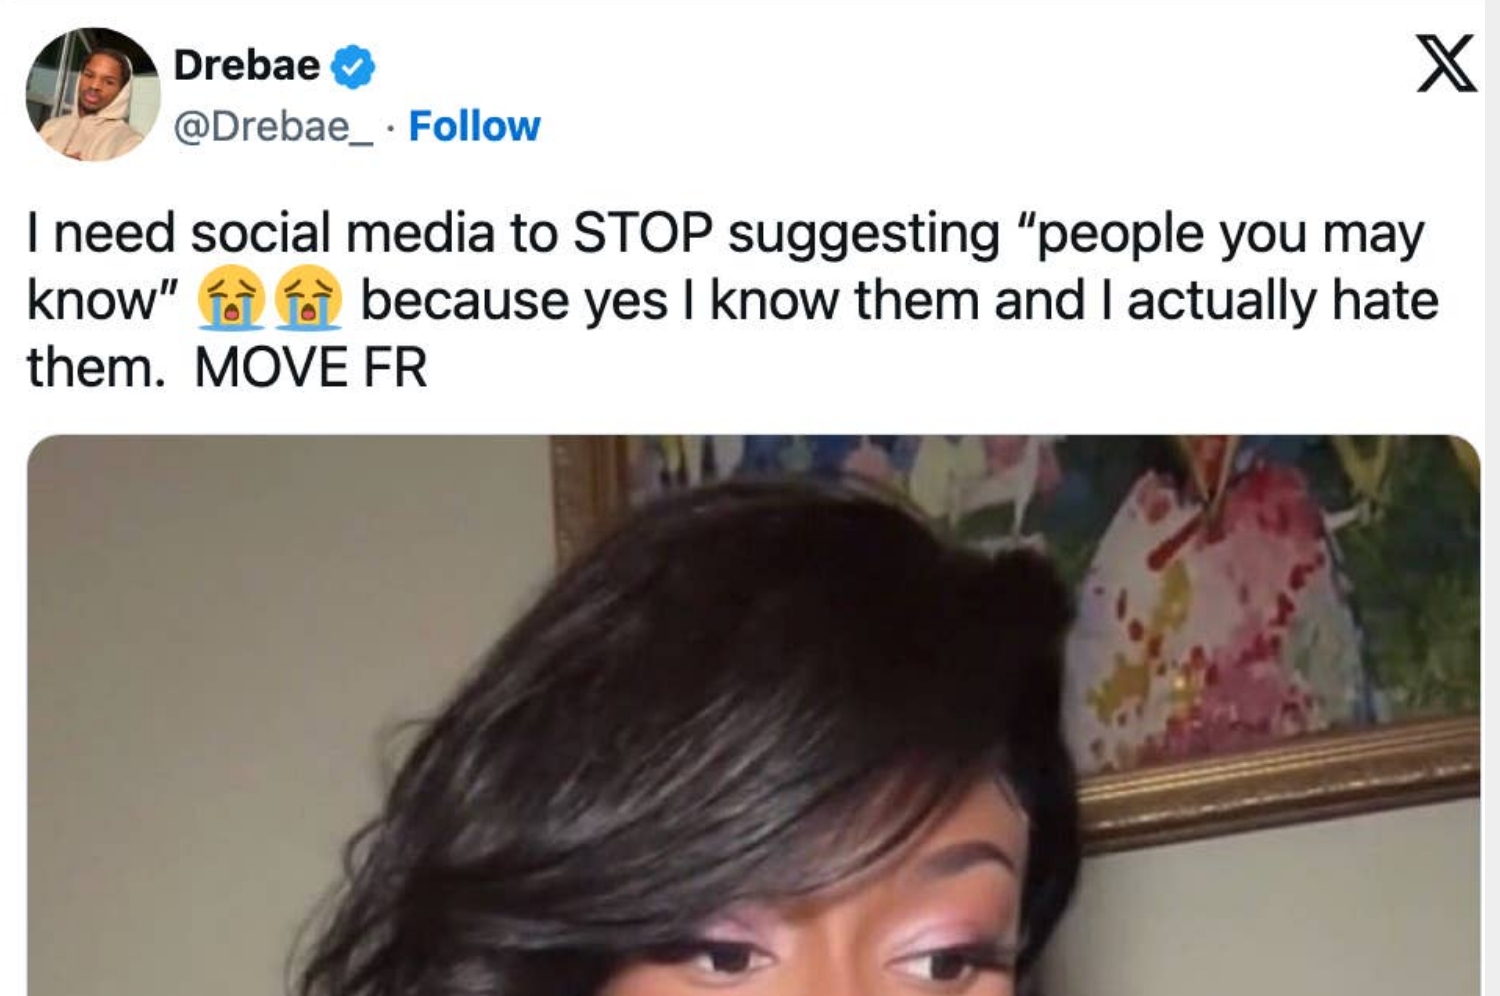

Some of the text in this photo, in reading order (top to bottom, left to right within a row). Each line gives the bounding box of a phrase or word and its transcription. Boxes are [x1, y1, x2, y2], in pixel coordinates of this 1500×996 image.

[174, 46, 321, 81] Drebae
[174, 107, 542, 147] @Drebae_ Follow
[28, 208, 1426, 264] I need social media to STOP suggesting “people you may
[28, 276, 1439, 331] know” because yes I know them and I actually hate
[25, 343, 428, 389] them. MOVE FR
